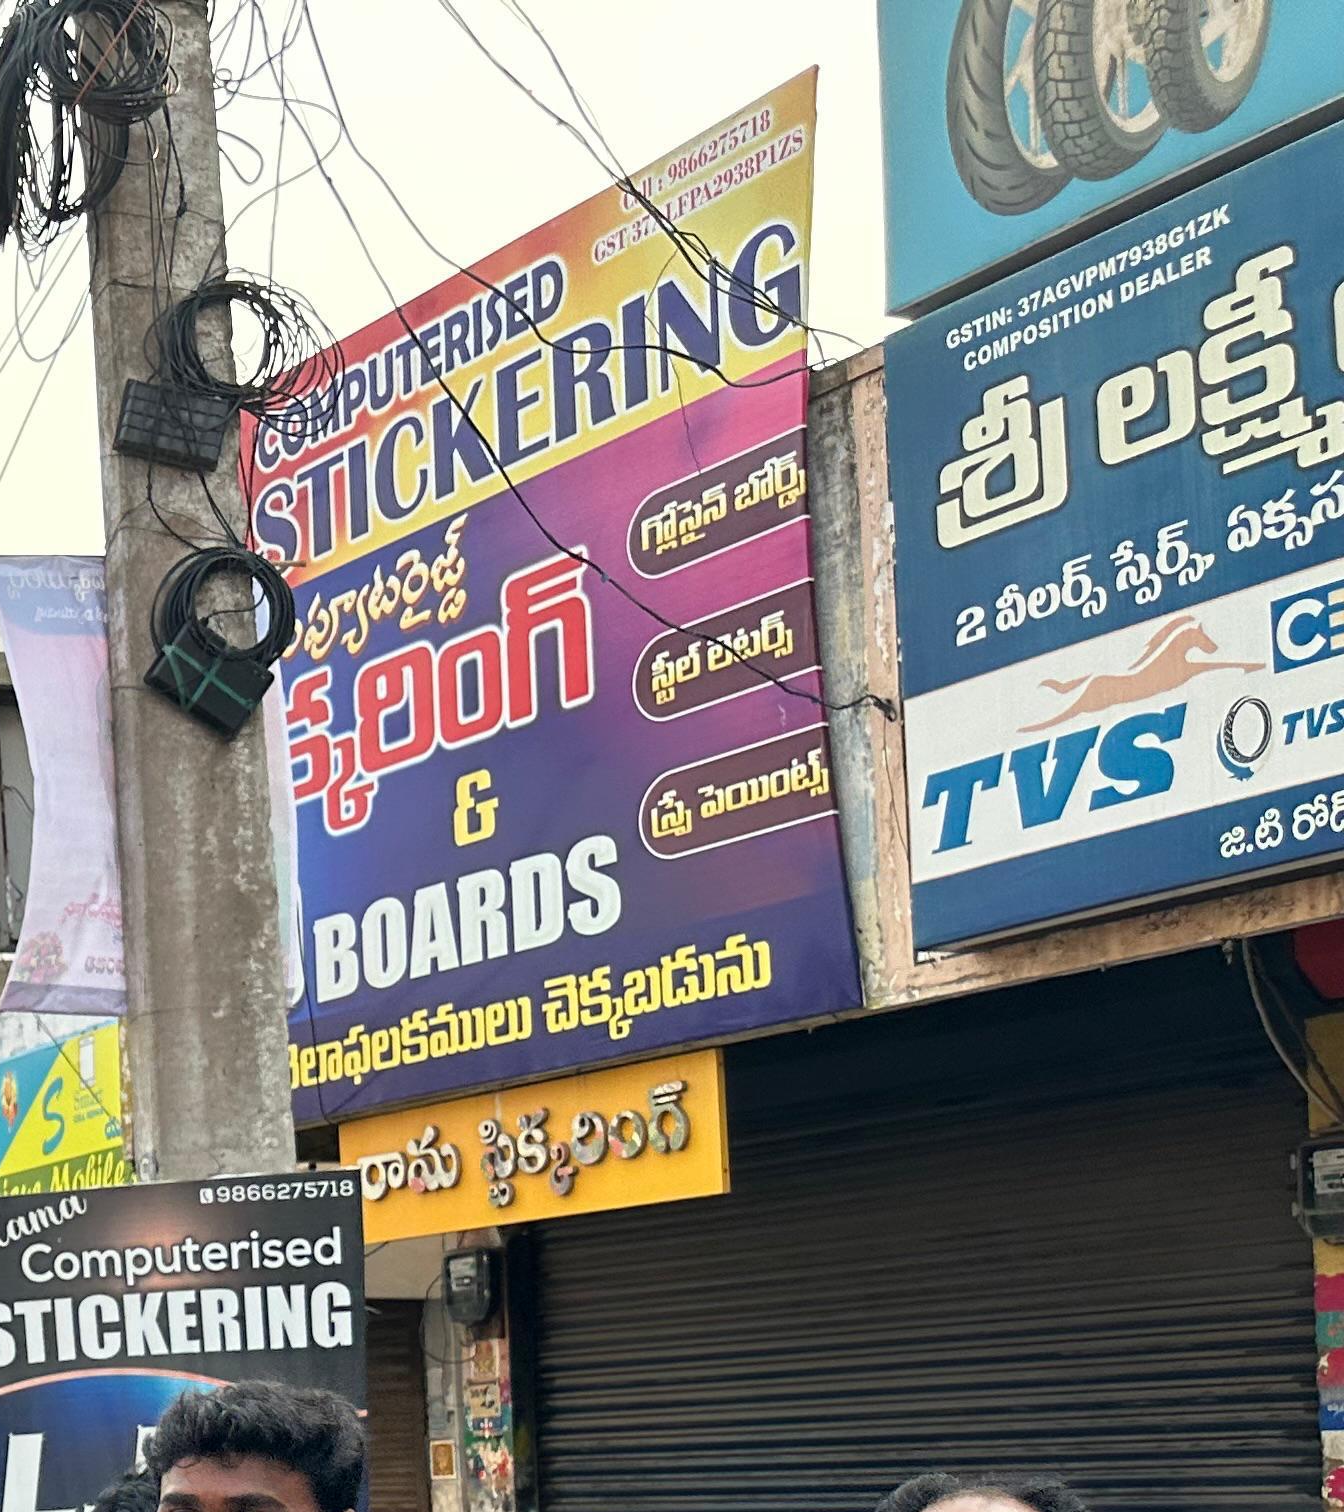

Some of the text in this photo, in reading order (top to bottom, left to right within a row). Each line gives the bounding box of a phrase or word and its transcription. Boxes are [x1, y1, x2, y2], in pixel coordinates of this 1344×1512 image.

[667, 109, 772, 186] 9866275718
[593, 229, 629, 264] GST
[946, 204, 1231, 350] GSTIN: 37AGVPM7938G1ZK
[963, 245, 1213, 371] COMPOSITION DEALER
[254, 222, 804, 574] STICKERING
[257, 259, 564, 468] COMPUTERISED
[936, 374, 1068, 549] శ్రీ
[956, 606, 987, 647] 2
[453, 768, 499, 845] &
[922, 702, 1188, 855] TVS
[313, 834, 622, 1004] BOARDS
[215, 1180, 354, 1204] 9866275718
[20, 1225, 343, 1286] Computerised
